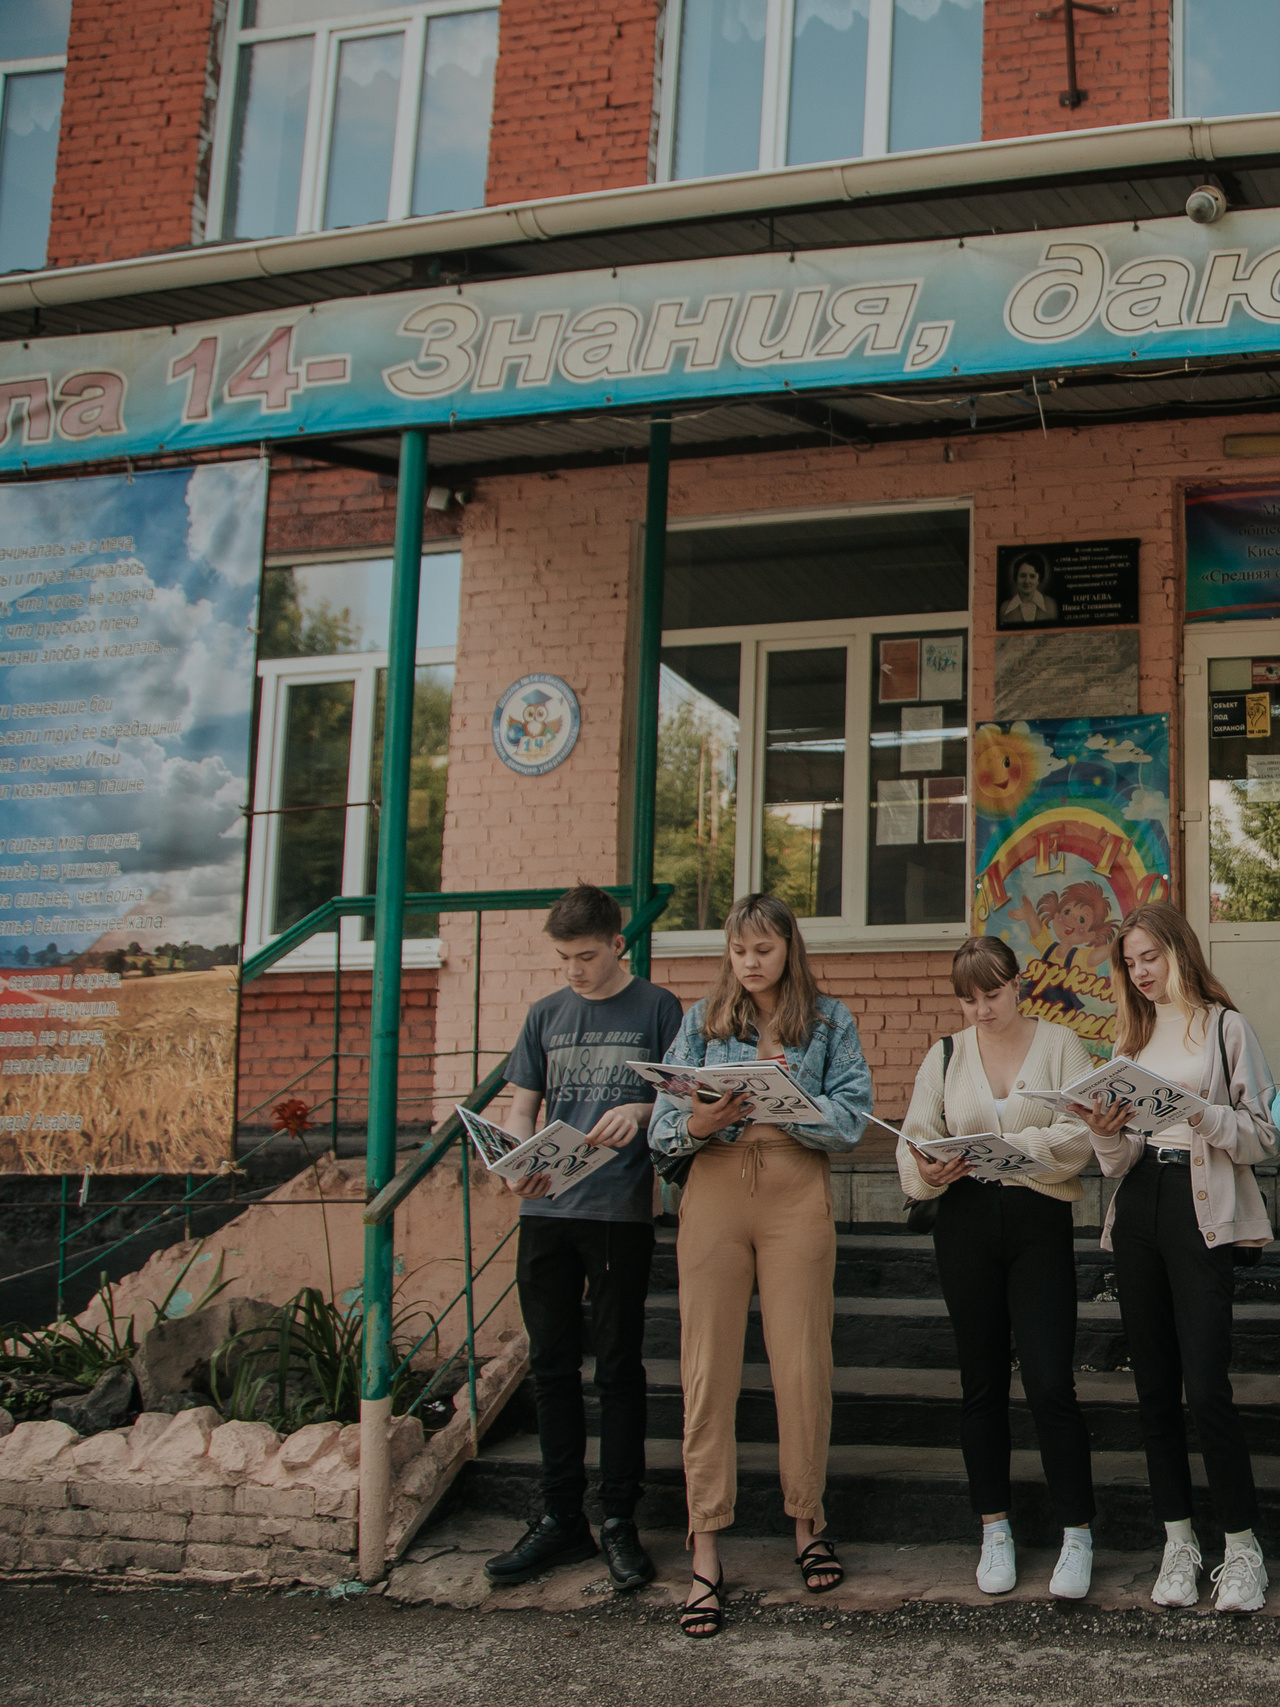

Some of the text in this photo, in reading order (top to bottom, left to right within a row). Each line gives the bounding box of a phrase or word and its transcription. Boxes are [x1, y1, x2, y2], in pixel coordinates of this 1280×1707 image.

[169, 323, 351, 425] 14-
[382, 277, 955, 399] Знания,
[70, 541, 87, 556] не
[27, 569, 65, 588] плуга
[1201, 571, 1270, 584] «Средняя
[17, 598, 44, 613] что
[88, 593, 105, 607] не
[6, 615, 140, 641] что русского плеча
[41, 644, 101, 662] злоба не
[12, 700, 87, 719] звеневшие
[89, 694, 115, 713] бои
[1213, 701, 1238, 710] ОБЪЕКТ
[1213, 714, 1228, 722] ПОД
[43, 724, 80, 747] труд
[1213, 723, 1246, 733] ОХРАНОЙ
[19, 754, 83, 775] могучего
[85, 749, 122, 769] Ильи
[11, 781, 77, 800] хозяином
[78, 780, 97, 795] на
[57, 834, 85, 851] моя
[40, 864, 60, 880] не
[77, 890, 104, 906] чем
[8, 974, 61, 991] светла
[38, 1029, 58, 1046] не
[580, 1031, 604, 1044] FOR
[604, 1031, 644, 1045] BRAVE
[32, 1111, 84, 1131] Асадов
